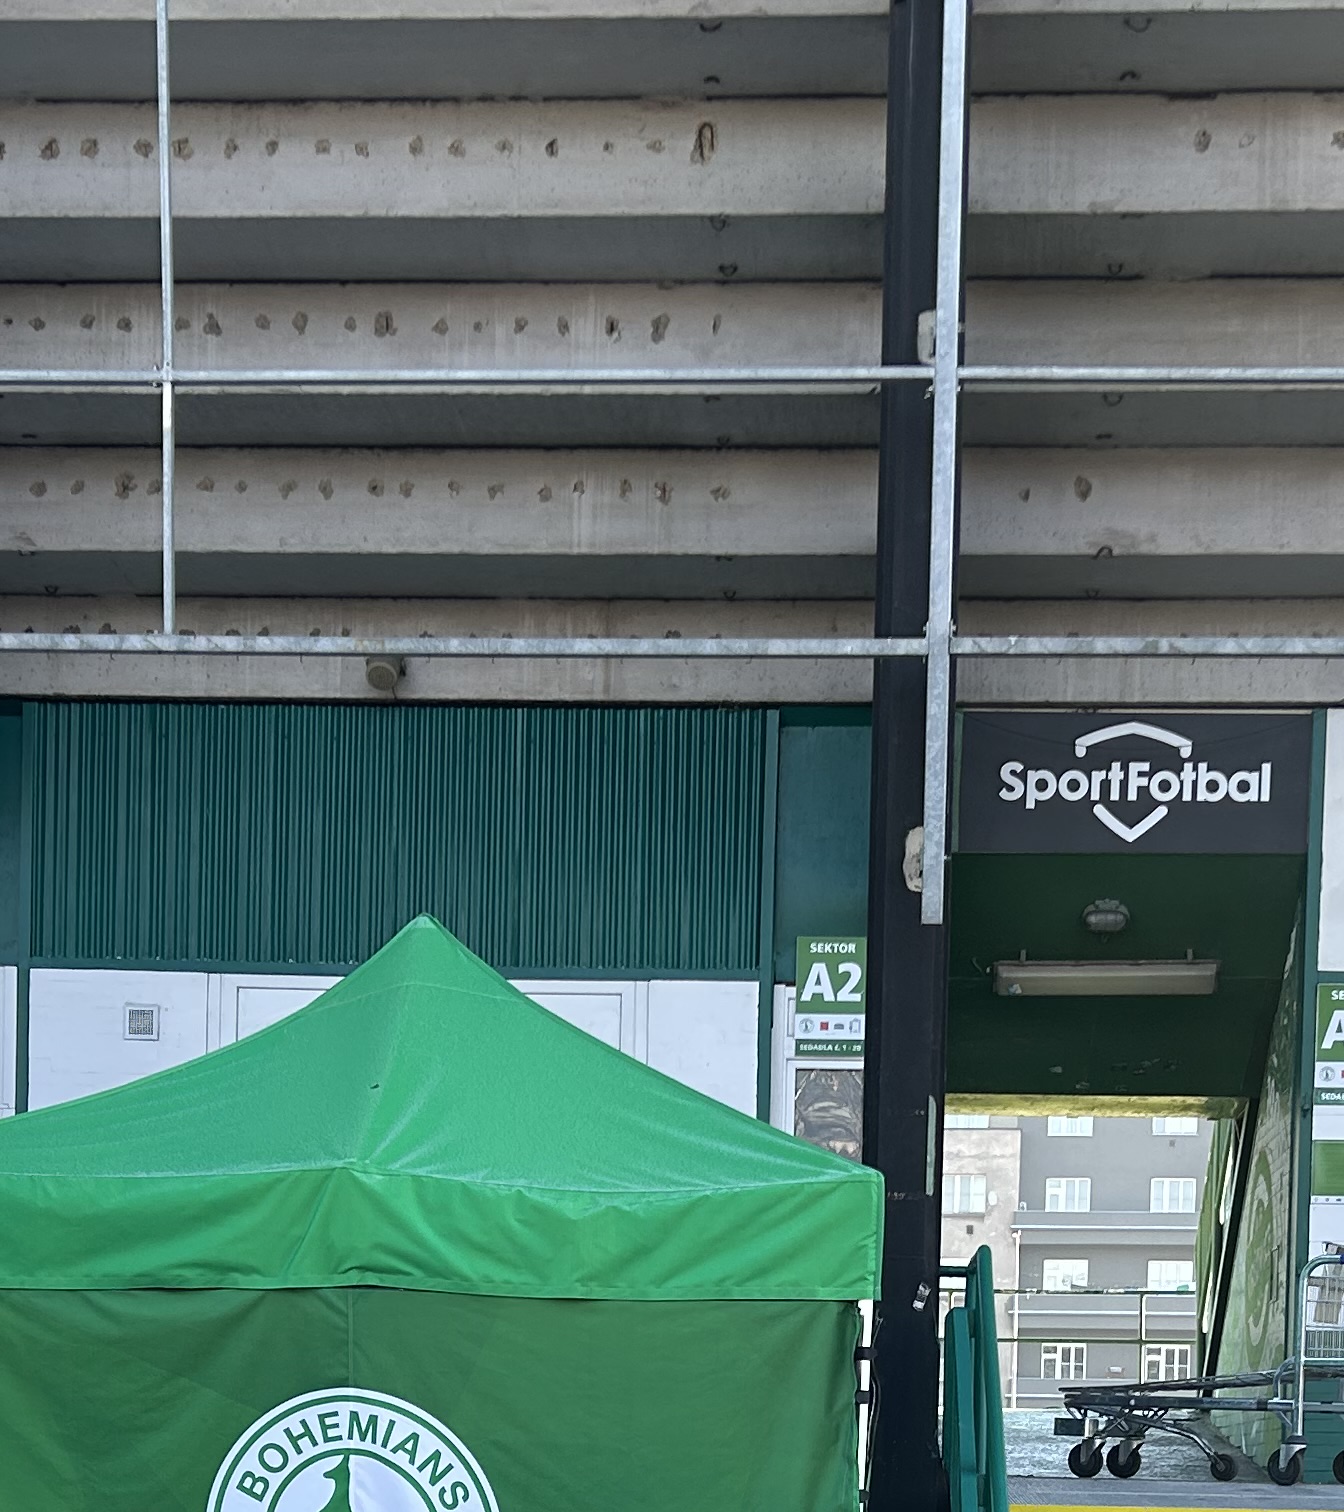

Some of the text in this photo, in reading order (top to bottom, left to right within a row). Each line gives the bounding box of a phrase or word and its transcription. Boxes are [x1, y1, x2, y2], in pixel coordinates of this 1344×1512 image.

[998, 760, 1272, 809] SportFotbal
[809, 942, 857, 954] SEKTOR
[800, 962, 865, 1002] A2
[235, 1410, 470, 1511] BOHEMIANS
